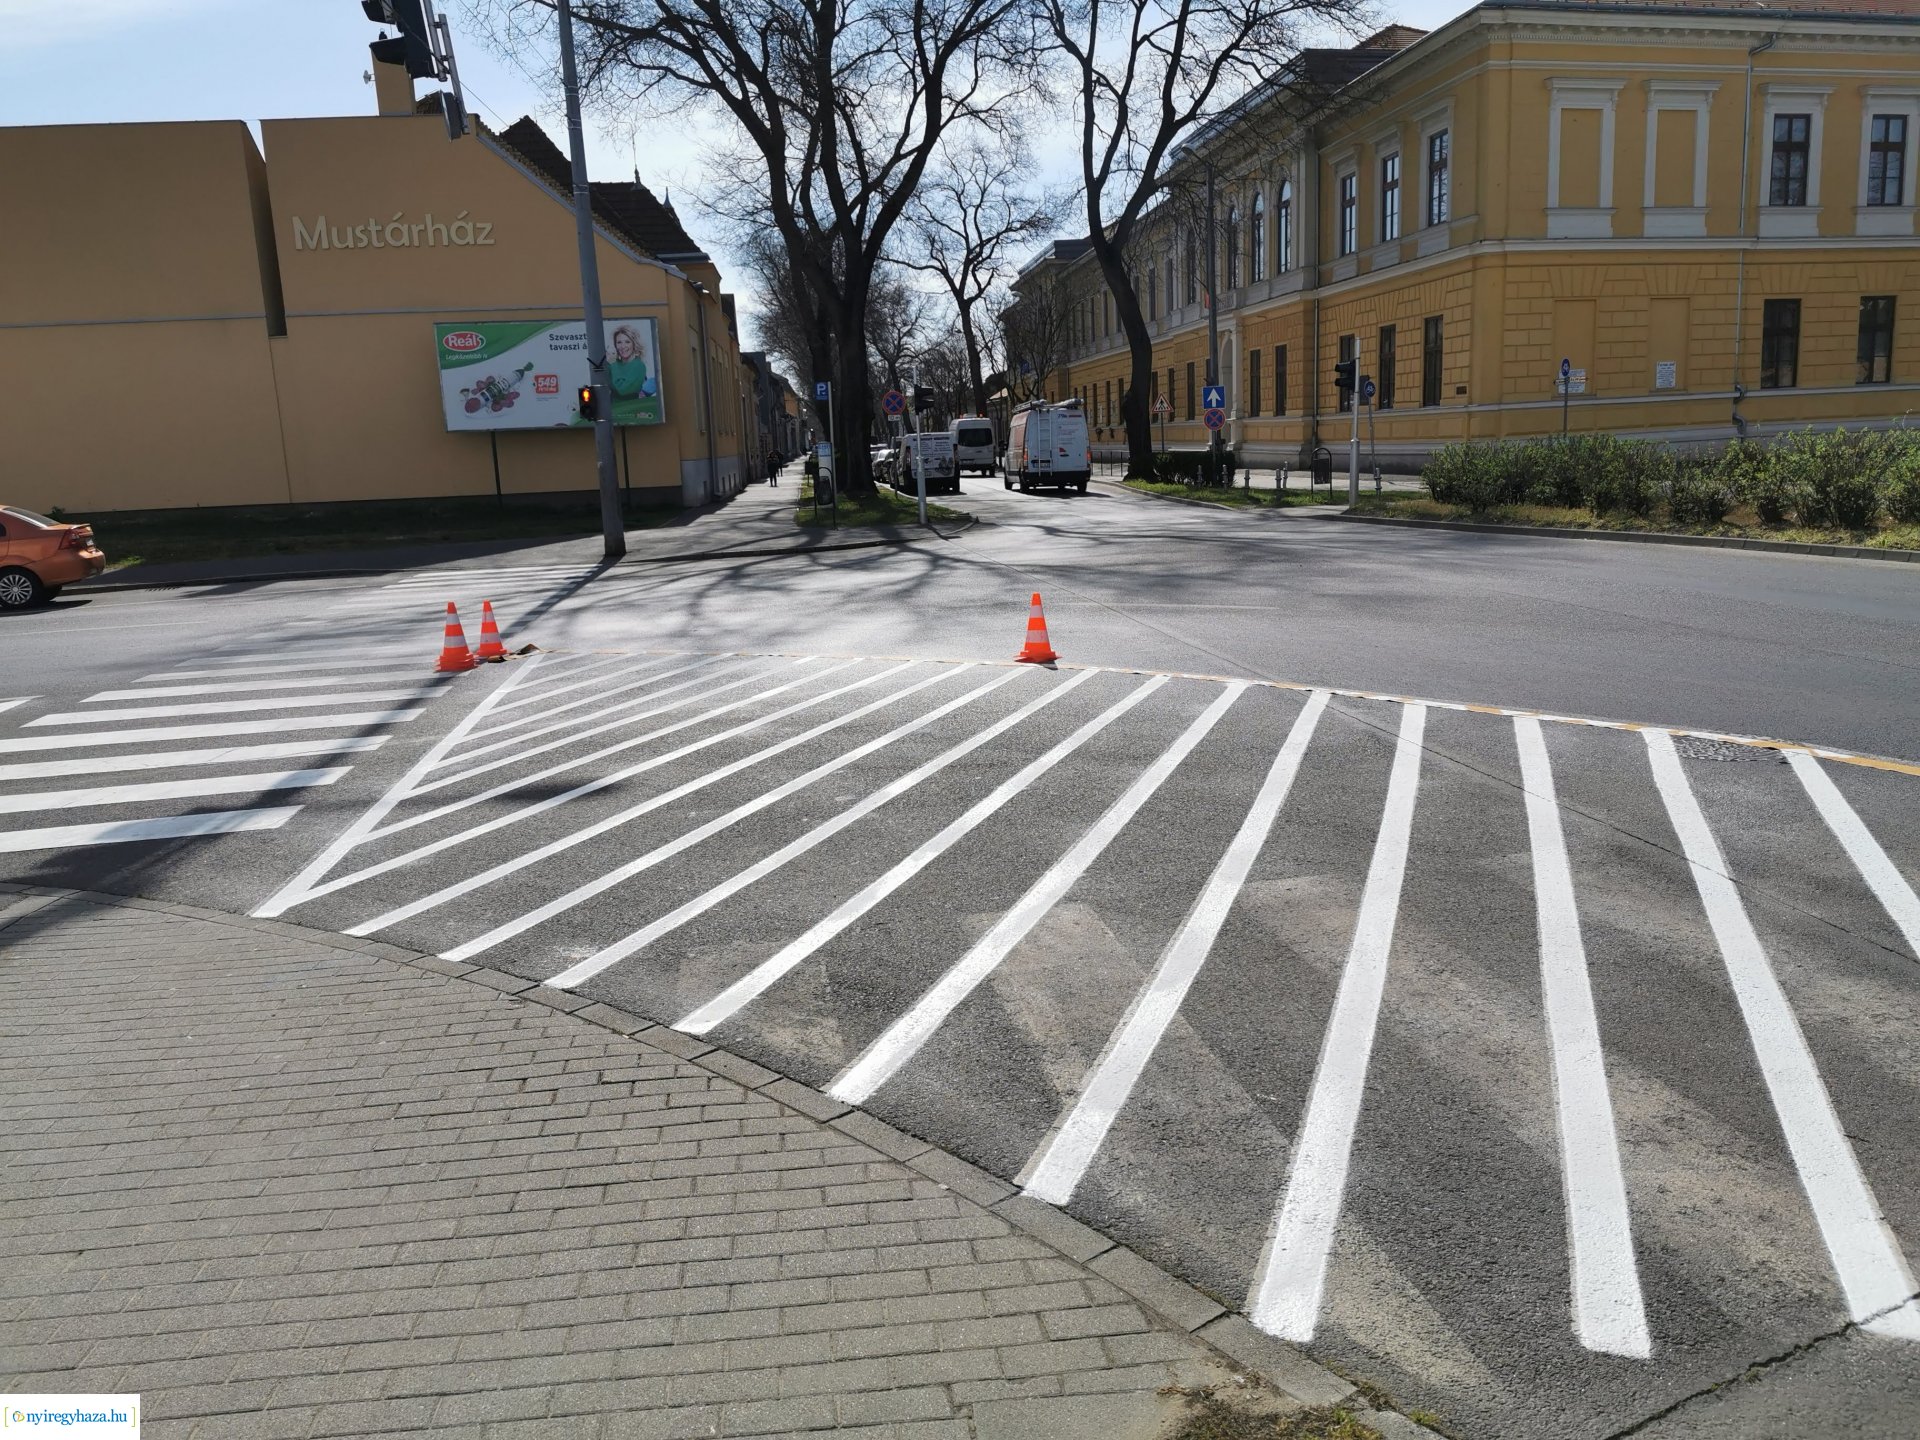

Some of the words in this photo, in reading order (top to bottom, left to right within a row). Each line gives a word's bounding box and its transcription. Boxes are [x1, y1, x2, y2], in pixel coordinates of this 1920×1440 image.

[292, 210, 495, 250] Mustárház
[448, 333, 477, 347] Reál
[549, 343, 580, 351] tavaszi
[537, 377, 557, 387] 549
